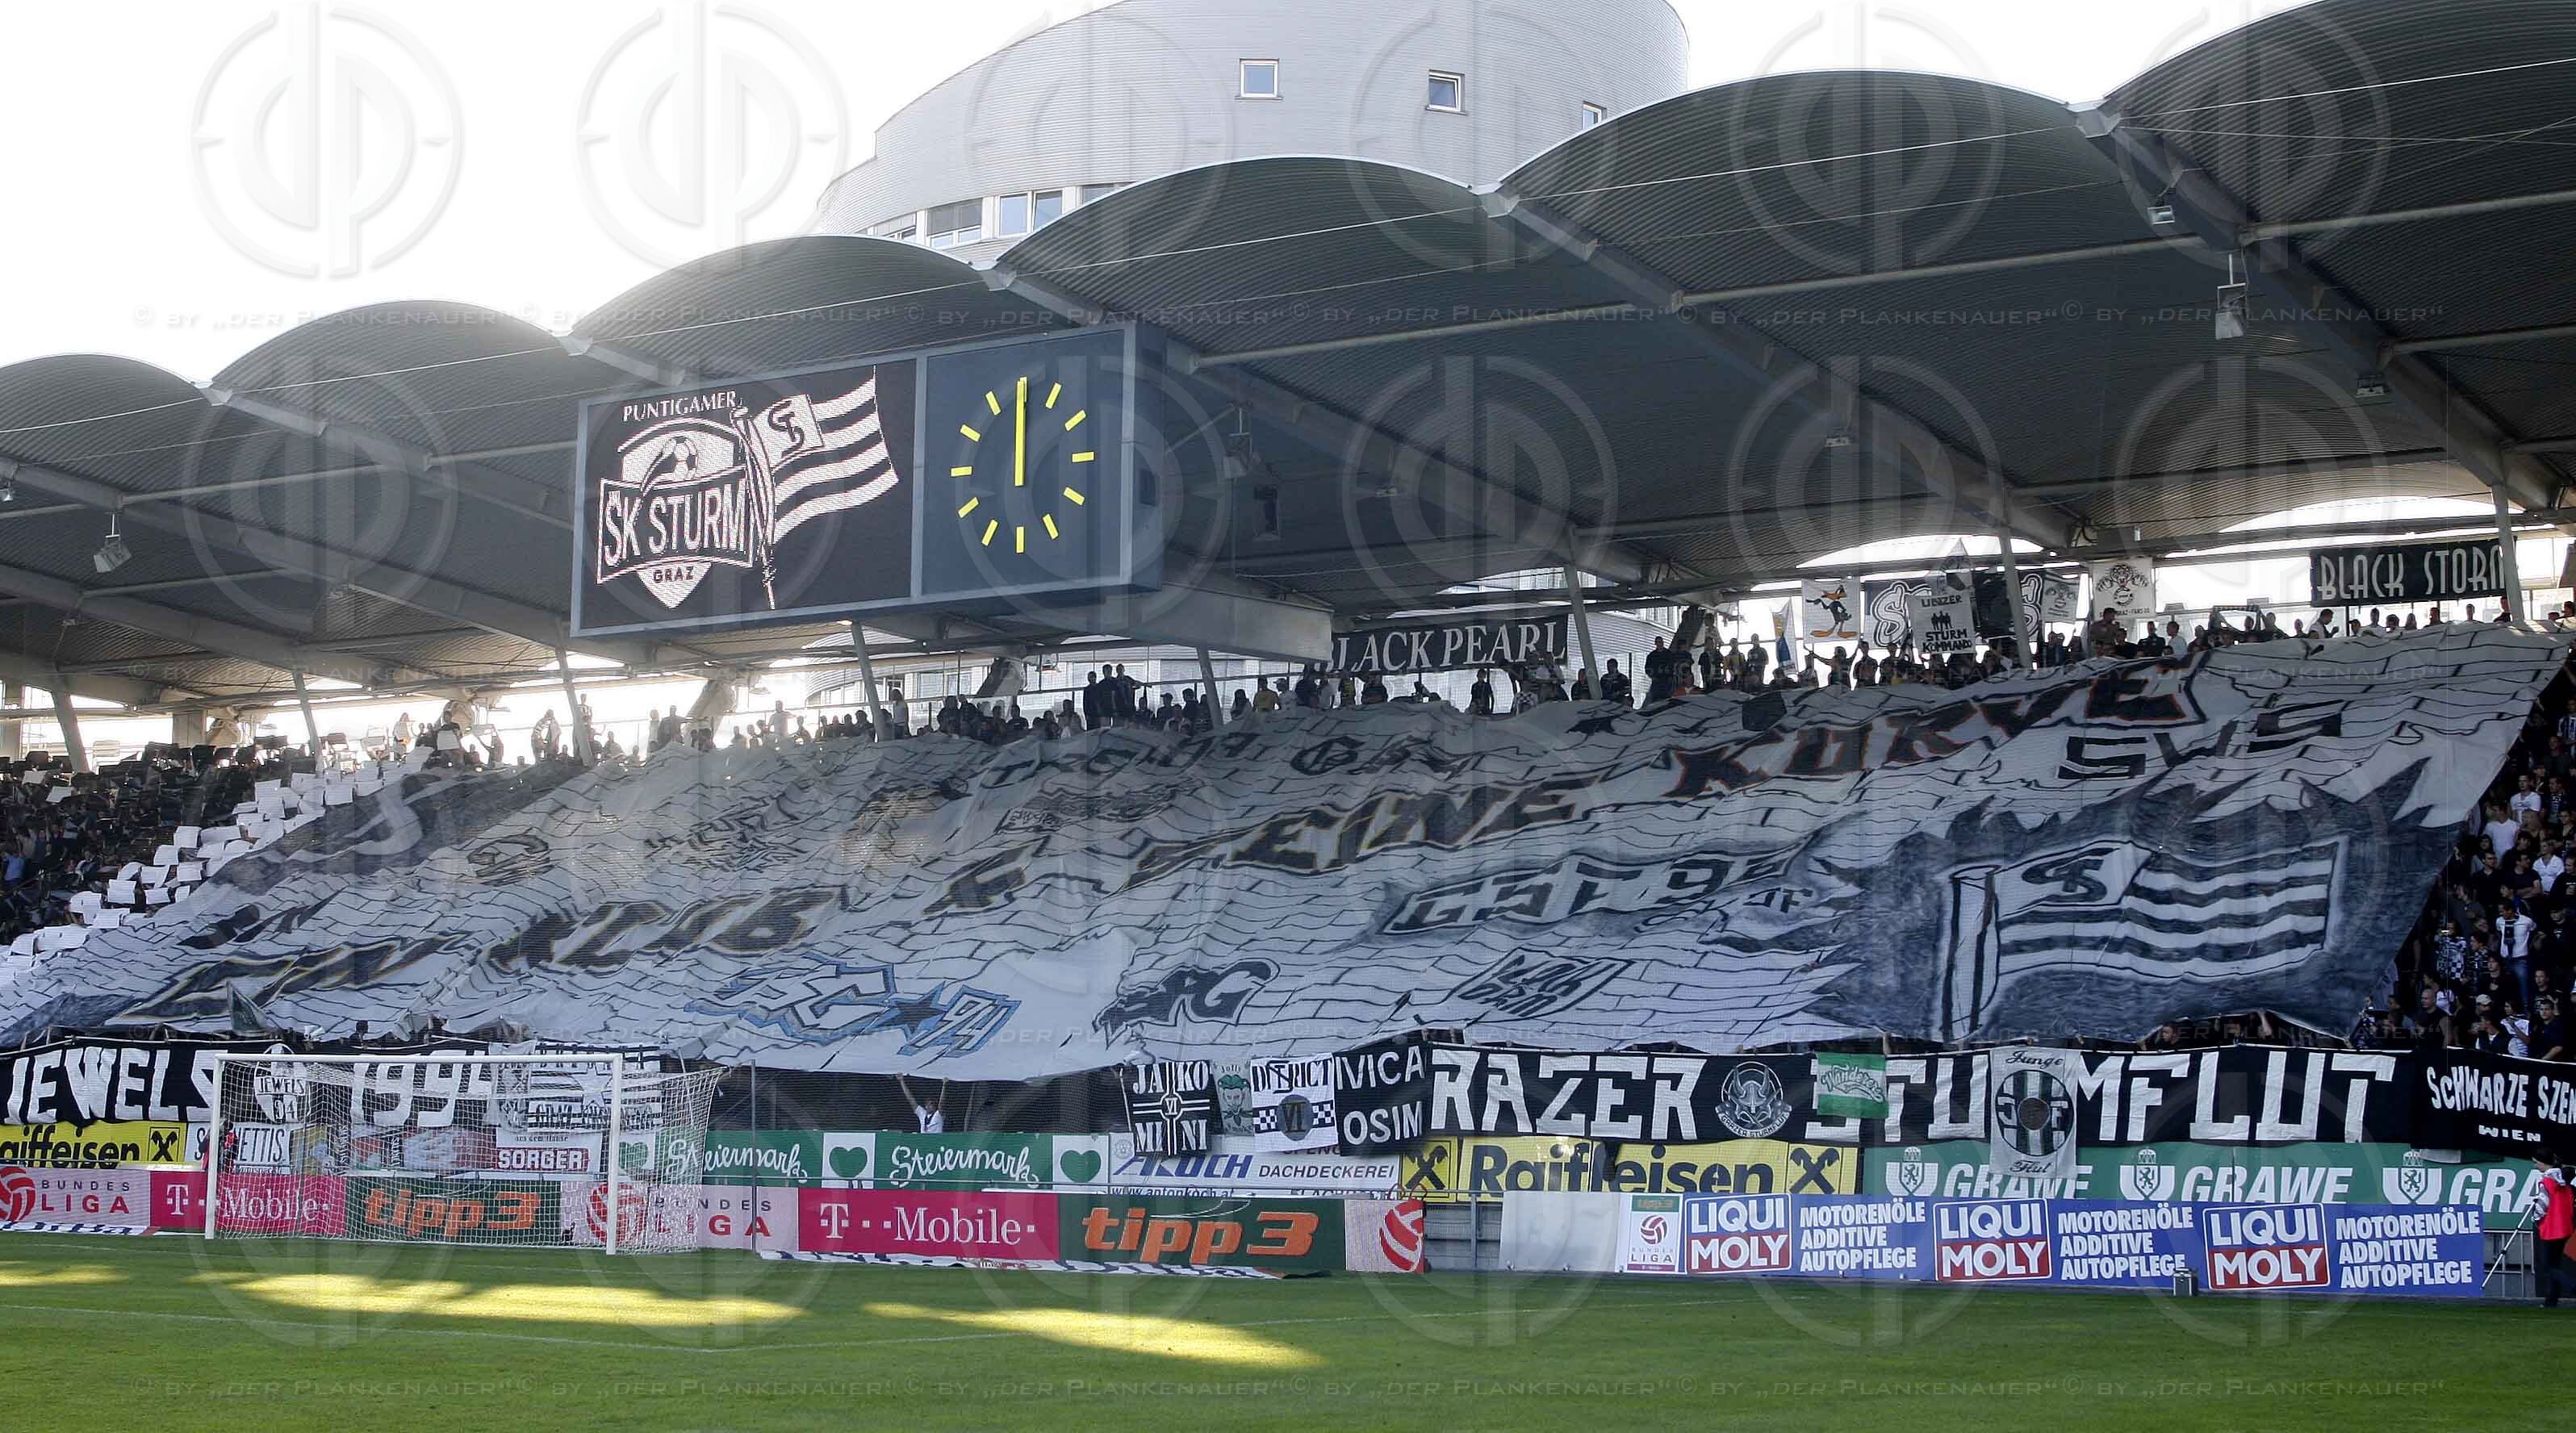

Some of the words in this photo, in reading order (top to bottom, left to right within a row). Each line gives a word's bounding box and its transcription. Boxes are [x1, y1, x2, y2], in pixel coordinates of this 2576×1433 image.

[624, 391, 736, 422] PUNTIGAMER
[604, 487, 642, 566] SK
[649, 478, 746, 555] STURM
[653, 565, 695, 583] GRAZ
[2317, 553, 2405, 601] BLACK
[1314, 631, 1434, 672] LACK
[1440, 620, 1567, 667] PEARL
[1926, 629, 1968, 641] STURM
[1336, 1045, 1426, 1090] IVICA
[2005, 1050, 2064, 1070] Junge
[3, 1047, 229, 1125] JEWELS
[2427, 1066, 2529, 1118] SCHWARZE
[1343, 1101, 1424, 1147] OSIM
[2478, 1125, 2541, 1142] WIEN
[497, 1148, 583, 1169] SORGER
[664, 1137, 808, 1184] Steiermark
[889, 1144, 1040, 1189] Steiermark
[1258, 1165, 1395, 1179] DACHDECKEREI
[41, 1180, 130, 1192] BUNDES
[2179, 1166, 2352, 1203] GRAWE
[41, 1194, 130, 1214] LIGA
[360, 1186, 539, 1238] tipp3
[1691, 1198, 1784, 1234] LIQUI
[1800, 1196, 1926, 1228] MOTORENÖLE
[1941, 1202, 2043, 1240] LIQUI
[2058, 1201, 2194, 1234] MOTORENÖLE
[1081, 1205, 1319, 1265] tipp3
[1800, 1226, 1888, 1250] ADDITIVE
[2210, 1205, 2319, 1247] LIQUI
[2336, 1206, 2481, 1240] MOTORENÖLE
[1631, 1253, 1673, 1263] LIGA
[1691, 1235, 1789, 1270] MOLY
[1800, 1247, 1917, 1272] AUTOPFLEGE
[1941, 1239, 2047, 1278] MOLY
[2060, 1233, 2154, 1257] ADDITIVE
[2339, 1239, 2438, 1264] ADDITIVE
[2211, 1245, 2325, 1287] MOLY
[2340, 1260, 2473, 1289] AUTOPFLEGE
